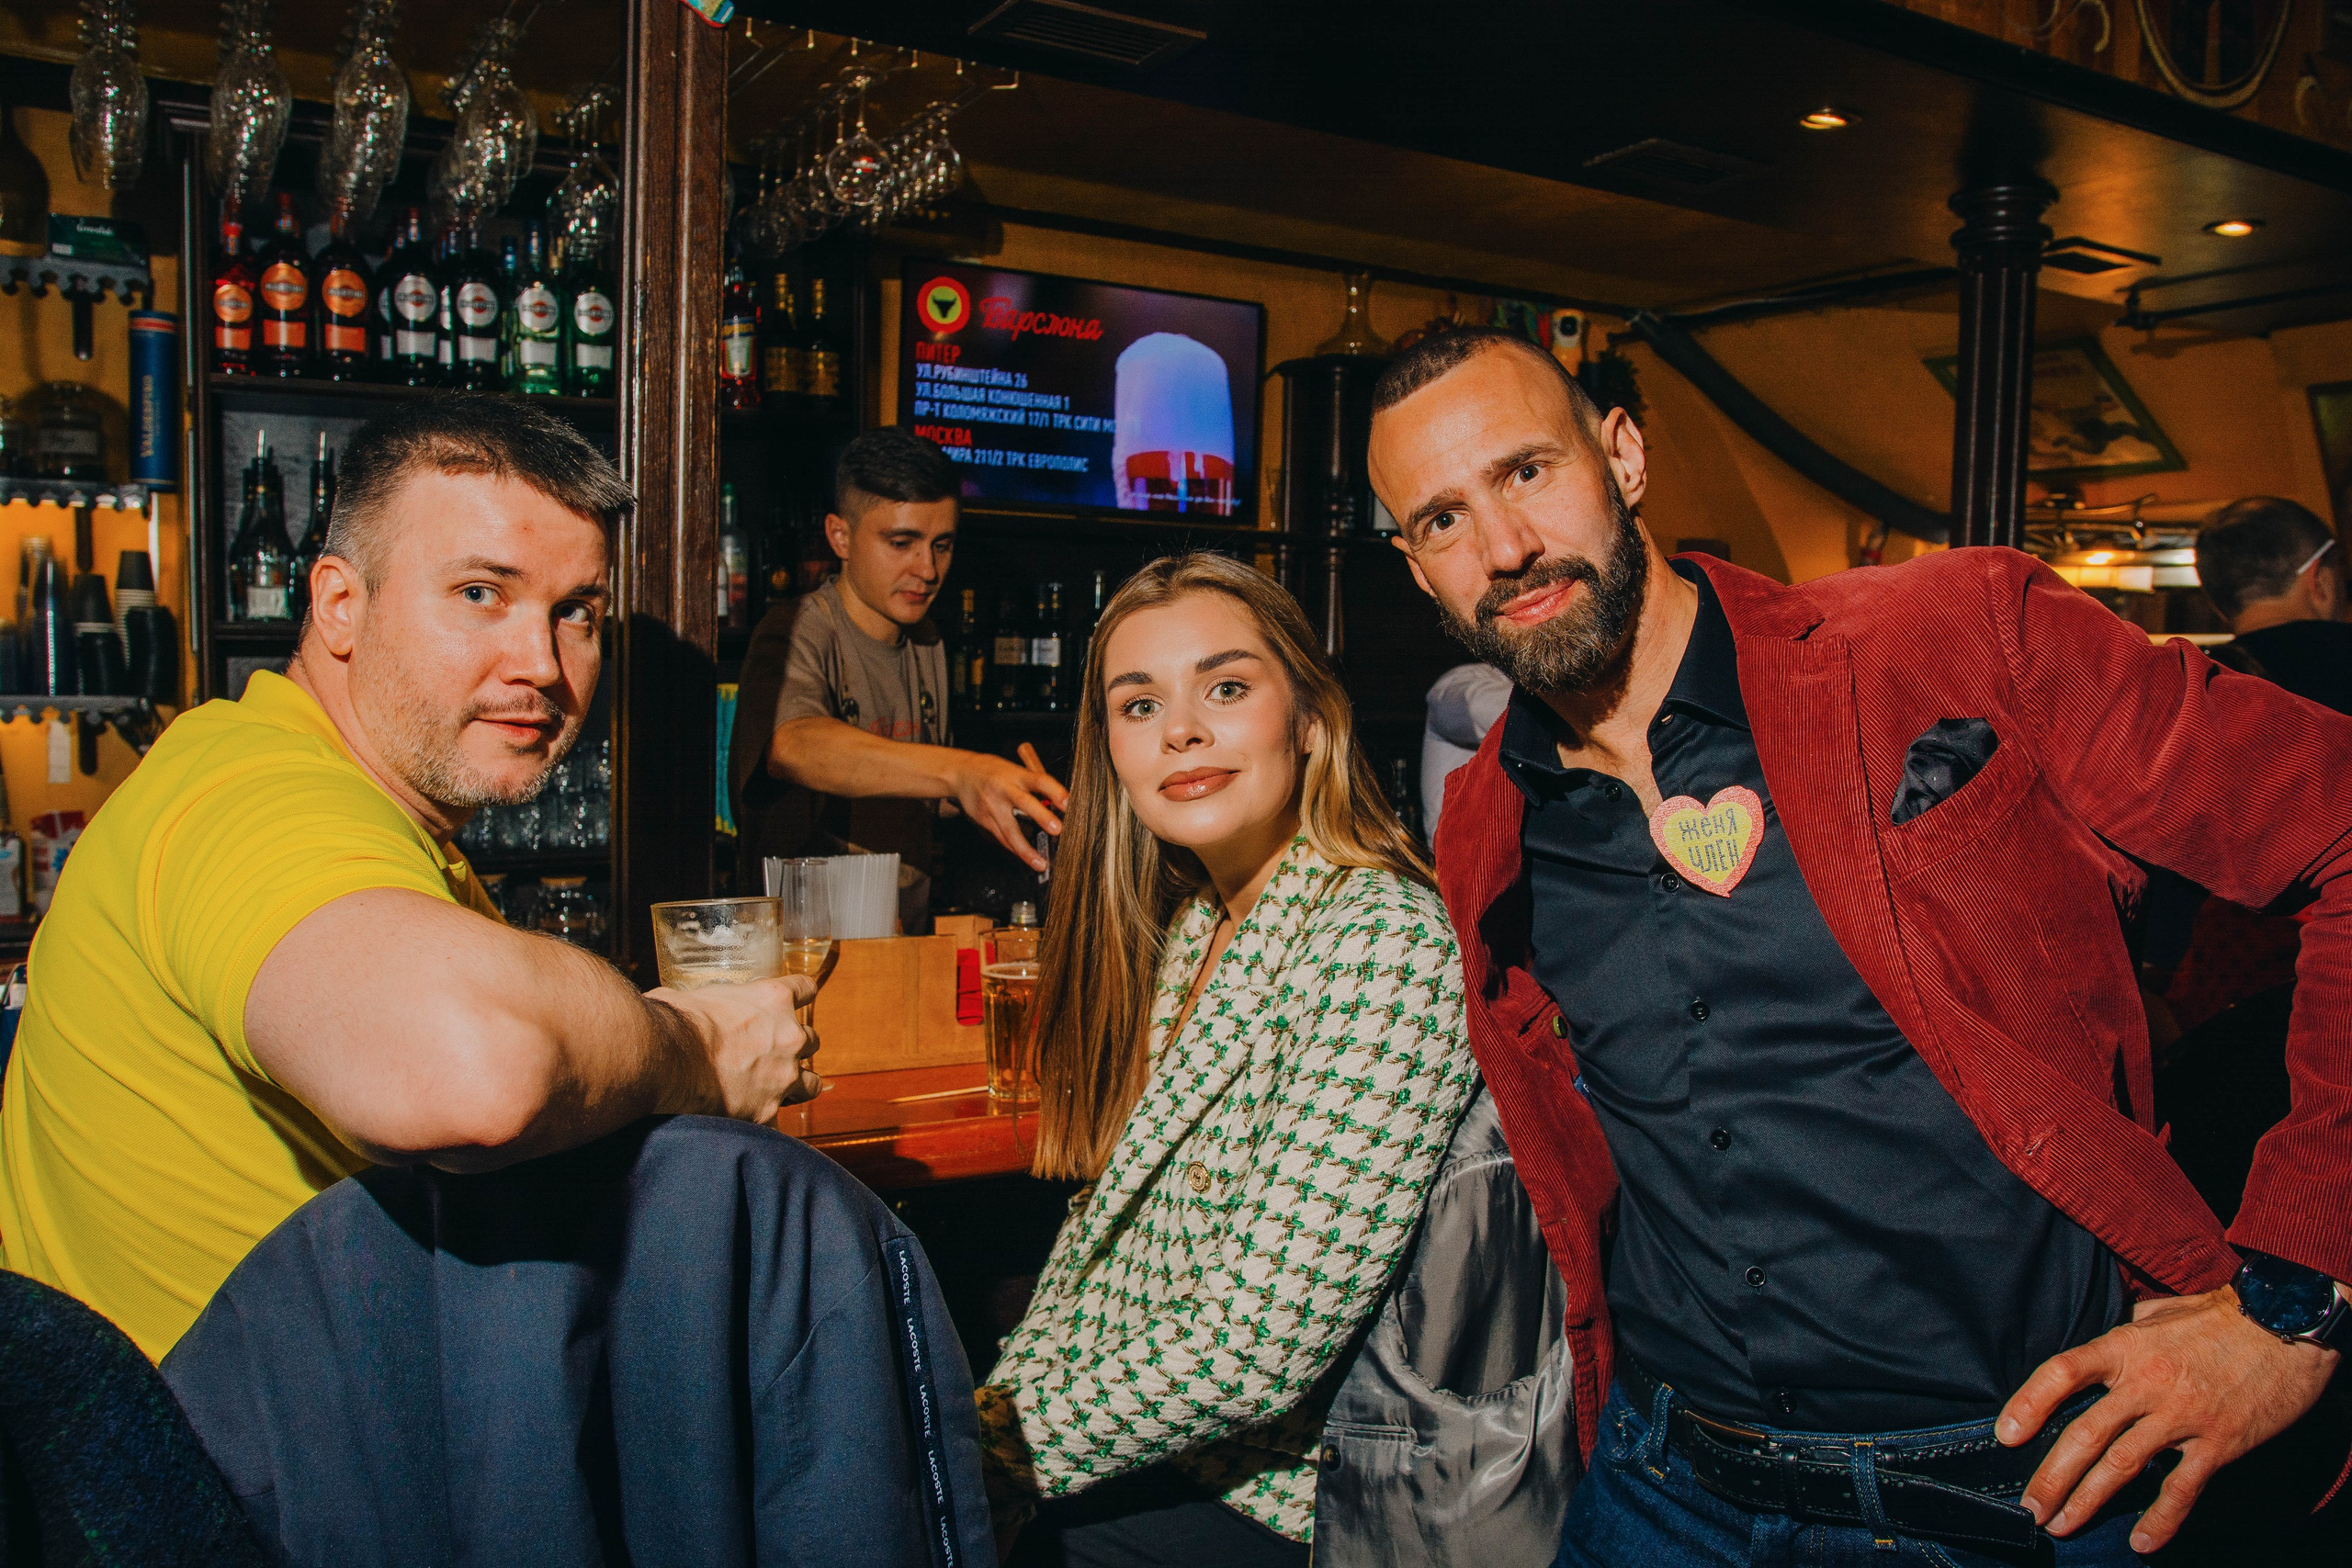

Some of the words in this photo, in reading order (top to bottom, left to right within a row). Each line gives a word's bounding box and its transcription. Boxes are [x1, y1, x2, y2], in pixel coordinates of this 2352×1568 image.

[978, 296, 1104, 342] Барслона
[915, 341, 962, 364] ПИТЕР
[1013, 372, 1029, 389] 26
[914, 400, 941, 419] ПР-Т
[1027, 412, 1050, 429] 17/1
[1051, 412, 1074, 431] ТРК
[1073, 415, 1102, 433] СИТИ
[987, 389, 1063, 411] КОНЮШЕННАЯ
[1063, 396, 1071, 412] 1
[914, 423, 973, 446] МОСКВА
[1005, 450, 1026, 468] ТРК
[1027, 452, 1090, 473] ЕВРОПОЛИС
[898, 1249, 911, 1305] LACOSTE
[906, 1317, 922, 1373] LACOSTE
[919, 1383, 932, 1438] LACOSTE
[927, 1449, 944, 1506] LACOSTE
[940, 1515, 954, 1568] LACOSTE
